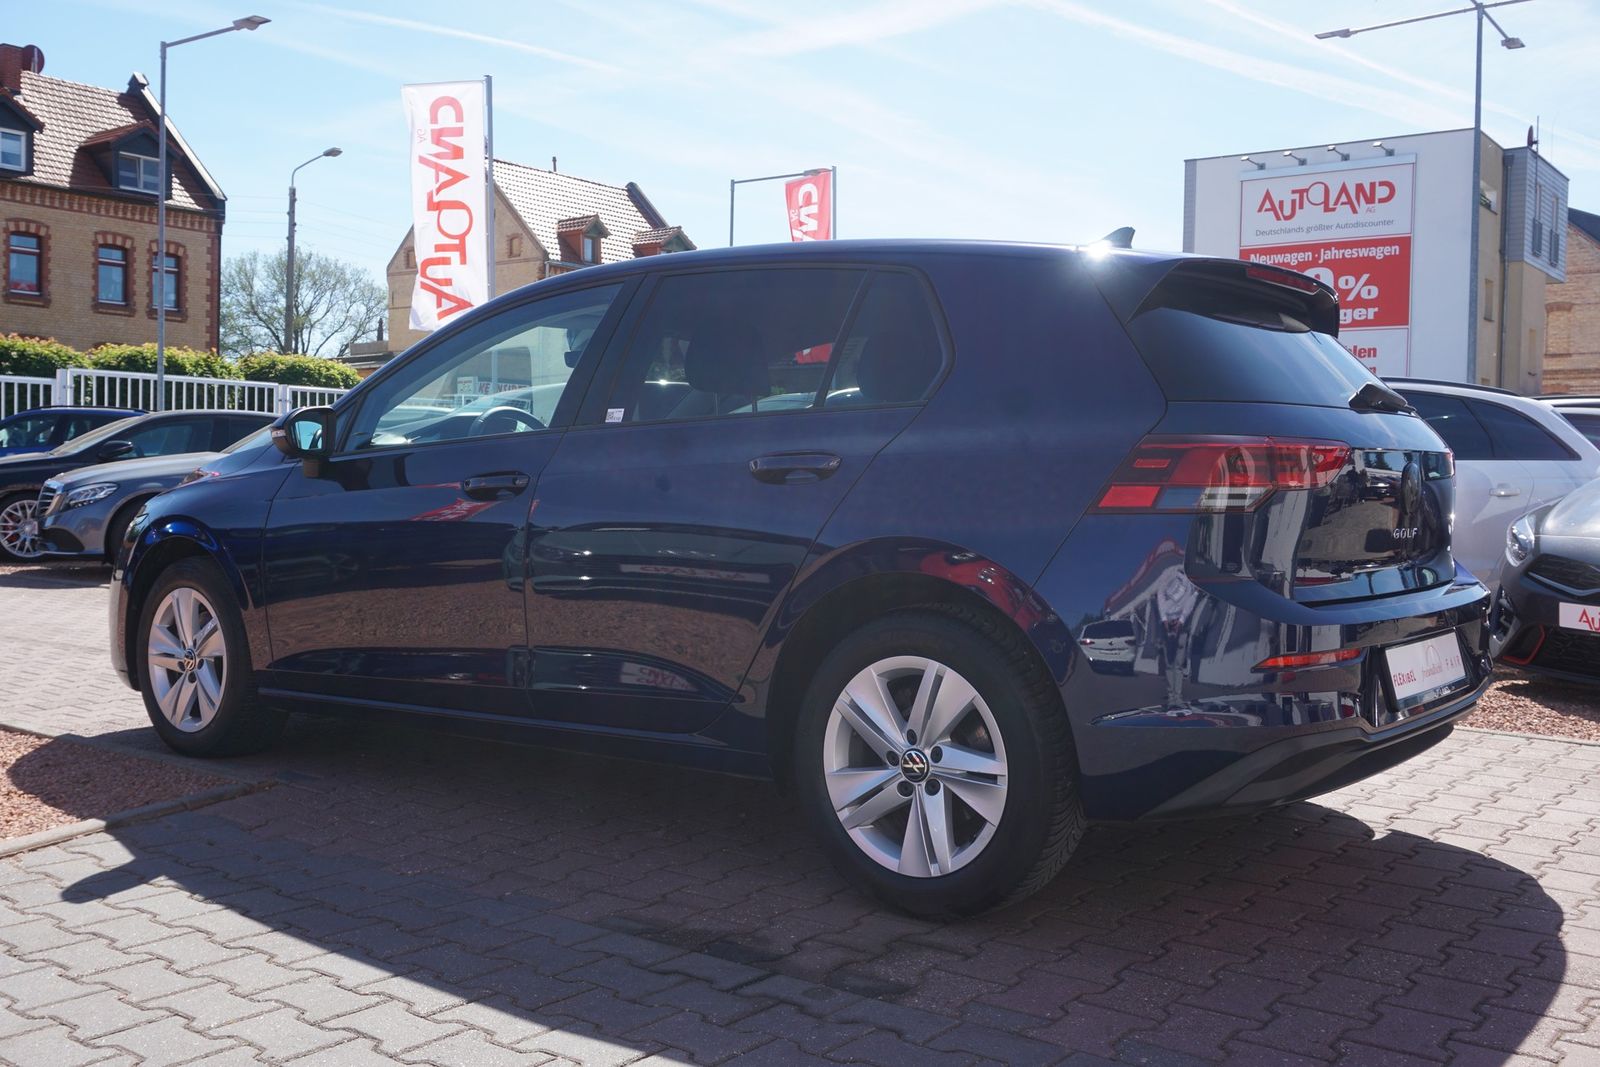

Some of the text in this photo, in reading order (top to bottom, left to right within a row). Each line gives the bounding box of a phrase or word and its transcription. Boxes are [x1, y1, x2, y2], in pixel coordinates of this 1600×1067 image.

[1257, 180, 1396, 221] AUTOLAND
[1365, 206, 1376, 214] AG
[1255, 218, 1395, 237] Deutschlands größter Autodiscounter
[1250, 245, 1400, 265] Neuwagen Jahreswagen
[1393, 527, 1418, 539] GOLF
